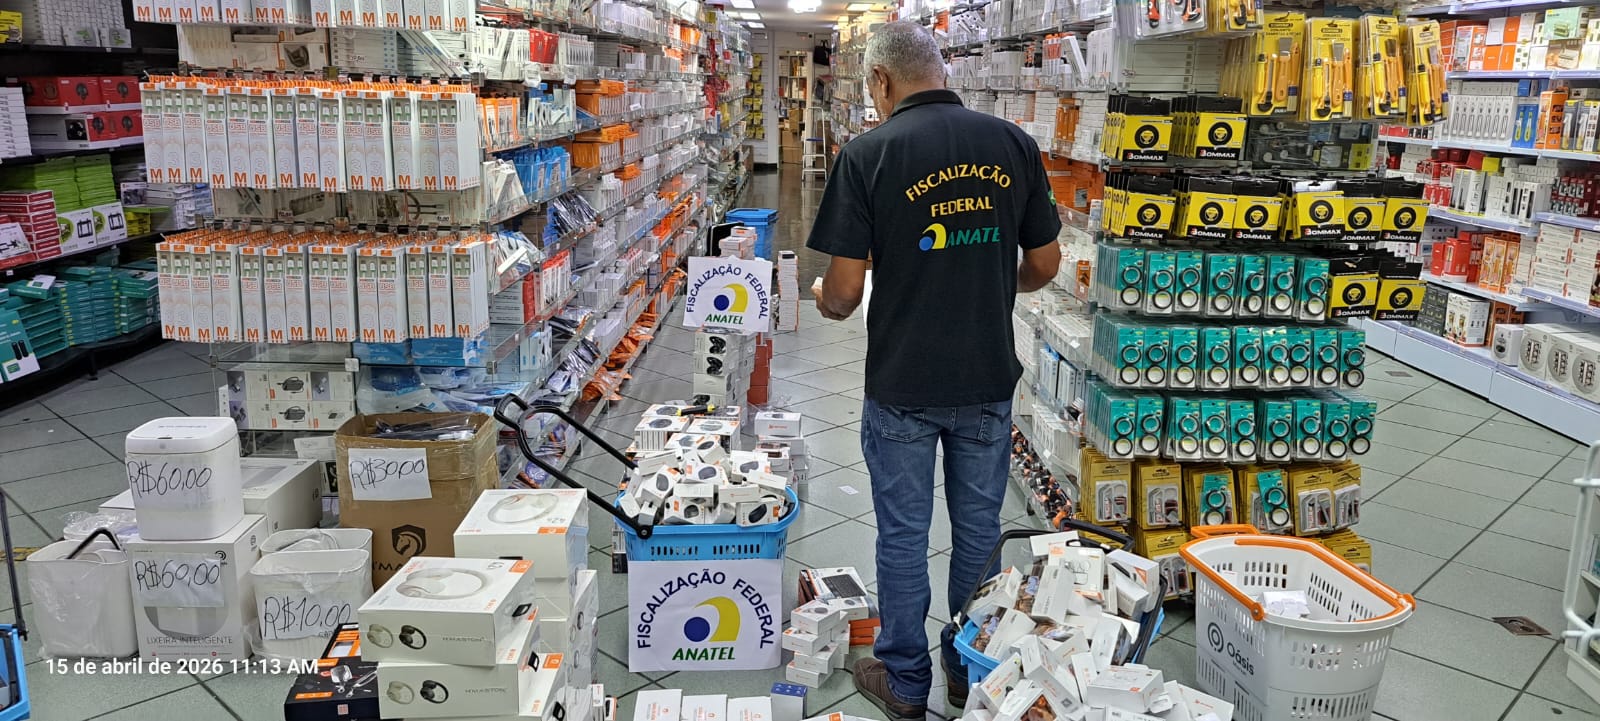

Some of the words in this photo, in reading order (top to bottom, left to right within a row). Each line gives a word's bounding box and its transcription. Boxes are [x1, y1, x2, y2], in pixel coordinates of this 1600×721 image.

[138, 6, 149, 16] M
[158, 7, 170, 18] M
[180, 8, 191, 18] M
[201, 6, 213, 17] M
[226, 8, 238, 18] M
[256, 8, 268, 18] M
[272, 8, 283, 18] M
[340, 10, 352, 21] M
[316, 12, 327, 22] M
[362, 12, 374, 23] M
[386, 13, 398, 23] M
[408, 15, 420, 26] M
[430, 15, 441, 26] M
[454, 17, 466, 28] M
[1127, 152, 1164, 161] BOMMAX
[1200, 149, 1236, 158] BOMMAX
[150, 169, 162, 179] M
[168, 168, 180, 178] M
[190, 168, 202, 178] M
[234, 172, 246, 183] M
[304, 173, 315, 183] M
[212, 174, 224, 184] M
[254, 174, 266, 184] M
[280, 173, 292, 184] M
[324, 177, 336, 188] M
[351, 175, 363, 186] M
[371, 176, 383, 187] M
[398, 175, 410, 186] M
[424, 176, 436, 186] M
[444, 176, 456, 186] M
[905, 163, 1011, 202] FISCALIZAÇÃO
[931, 196, 994, 217] FEDERAL
[1128, 228, 1163, 239] BOMMAX
[1190, 228, 1226, 238] BOMMAX
[1235, 232, 1271, 240] BOMMAX
[1384, 232, 1416, 240] BOMMAX
[686, 264, 741, 312] FISCALIZAÇÃO
[745, 273, 768, 319] FEDERAL
[705, 313, 744, 324] ANATEL
[178, 327, 190, 337] M
[198, 329, 210, 339] M
[217, 327, 228, 337] M
[247, 329, 259, 339] M
[271, 330, 282, 340] M
[291, 327, 302, 337] M
[315, 328, 326, 338] M
[335, 328, 347, 338] M
[363, 329, 375, 340] M
[384, 330, 395, 340] M
[412, 326, 424, 336] M
[434, 325, 445, 335] M
[458, 325, 470, 335] M
[127, 460, 212, 498] R$60,00
[135, 560, 219, 591] R$60,00
[637, 569, 726, 648] FISCALIZAÇÃO
[732, 578, 774, 649] FEDERAL
[672, 647, 735, 660] ANATEL
[1227, 642, 1254, 675] Oásis
